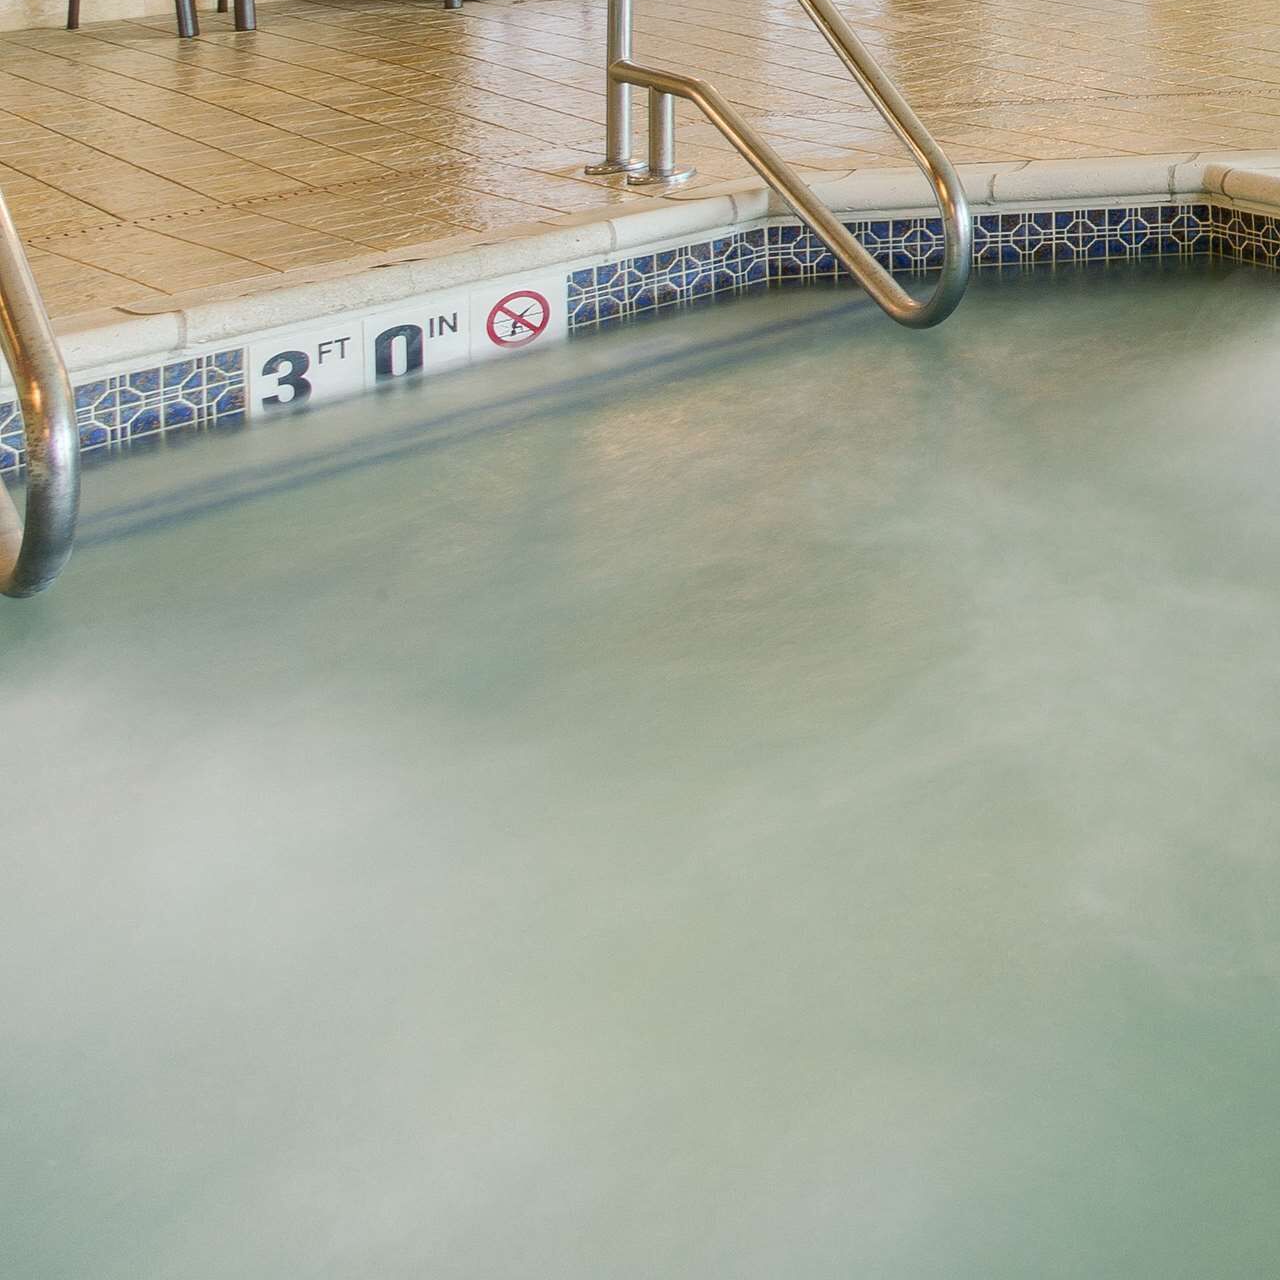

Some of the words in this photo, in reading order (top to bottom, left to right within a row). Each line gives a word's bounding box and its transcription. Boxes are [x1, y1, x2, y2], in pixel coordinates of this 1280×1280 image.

[262, 349, 312, 408] 3
[318, 336, 351, 364] FT
[375, 323, 424, 383] 0
[429, 312, 458, 338] IN
